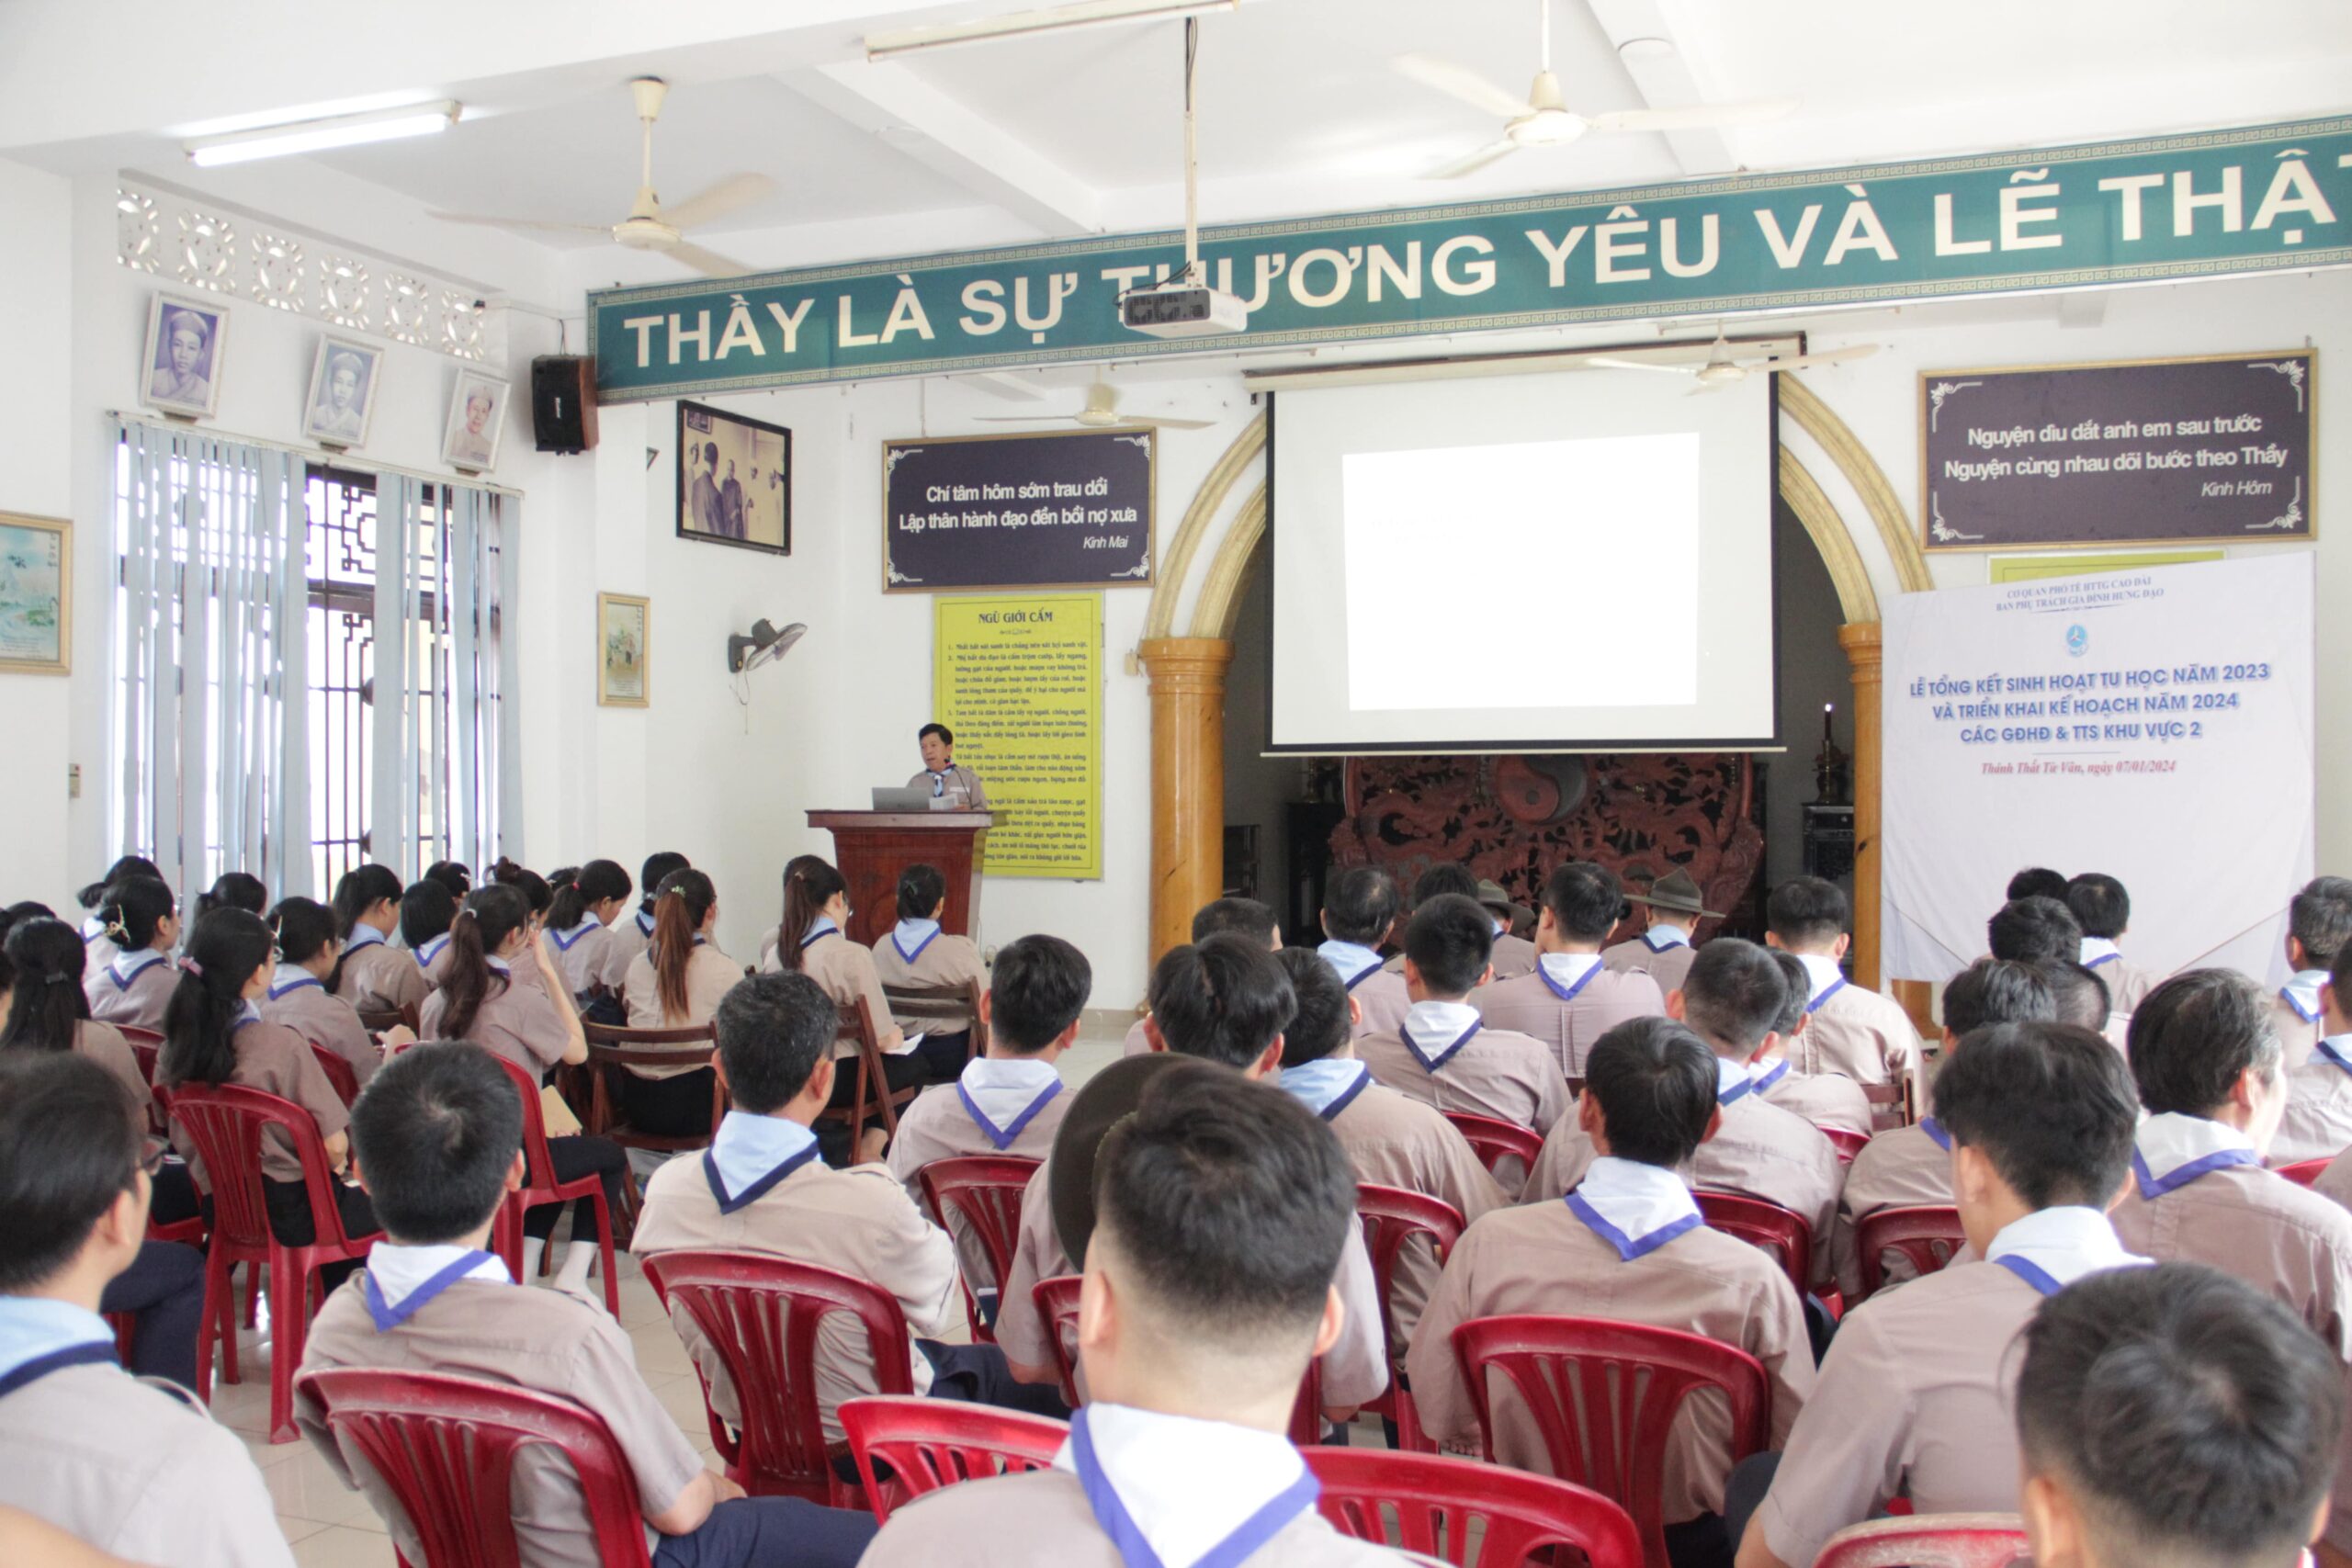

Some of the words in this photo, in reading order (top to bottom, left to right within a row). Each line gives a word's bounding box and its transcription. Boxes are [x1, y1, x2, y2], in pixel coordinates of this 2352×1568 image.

[624, 294, 815, 367] THẦY
[838, 274, 934, 349] LÀ
[960, 273, 1079, 344] SỰ
[1525, 205, 1720, 288] YÊU
[1753, 184, 1899, 269] VÀ
[1934, 167, 2064, 257] LẼ
[2098, 148, 2352, 245] THẬ
[1967, 425, 2036, 450] Nguyện
[2039, 423, 2069, 444] dìu
[2070, 418, 2101, 442] dắt
[2103, 420, 2139, 440] anh
[2142, 422, 2172, 438] em
[2176, 420, 2211, 436] sau
[2213, 413, 2262, 434] trước
[1944, 459, 2012, 483] Nguyện
[2015, 456, 2062, 479] cùng
[2064, 455, 2110, 474] nhau
[2112, 451, 2143, 471] dõi
[2145, 449, 2192, 470] bước
[2196, 448, 2238, 468] theo
[2244, 443, 2288, 468] Thầy
[926, 485, 951, 503] Chí
[952, 484, 980, 502] tâm
[982, 483, 1016, 501] hôm
[1018, 481, 1051, 500] sớm
[1053, 481, 1082, 498] trau
[1084, 476, 1109, 497] dồi
[2201, 481, 2234, 498] Kinh
[2236, 479, 2273, 496] Hôm
[899, 513, 926, 534] Lập
[928, 512, 959, 530] thân
[961, 510, 998, 528] hành
[1000, 510, 1029, 530] đạo
[1030, 506, 1058, 526] đền
[1060, 504, 1085, 525] bồi
[1087, 507, 1109, 527] nợ
[1110, 506, 1138, 524] xưa
[1082, 536, 1108, 549] Kinh
[1108, 535, 1129, 549] Mai
[2021, 587, 2047, 598] QUAN
[2110, 578, 2132, 589] CAO
[1996, 602, 2014, 612] BAN
[2067, 595, 2085, 605] GIA
[1909, 676, 1928, 699] LỄ
[1928, 673, 1974, 698] TỔNG
[1975, 672, 2005, 699] KẾT
[2006, 675, 2047, 694] SINH
[2049, 672, 2098, 694] HOẠT
[2100, 671, 2122, 689] TU
[2125, 669, 2169, 689] HỌC
[2173, 663, 2219, 683] NĂM
[2222, 662, 2271, 681] 2023
[1932, 701, 1956, 721] VÀ
[1958, 695, 2002, 720] TRIỂN
[2004, 701, 2046, 718] KHAI
[2049, 694, 2073, 716] KẾ
[2073, 697, 2141, 717] HOẠCH
[2144, 692, 2188, 712] NĂM
[2192, 693, 2239, 709] 2024
[1960, 724, 1999, 744] CÁC
[2001, 726, 2053, 743] GĐHĐ
[2055, 726, 2070, 741] &
[2073, 724, 2101, 741] TTS
[2104, 723, 2142, 739] KHU
[2144, 720, 2186, 741] VỰC
[2189, 721, 2202, 737] 2
[1982, 761, 2015, 775] Thánh
[2086, 761, 2114, 776] ngày
[2115, 760, 2177, 773] 07/01/2024
